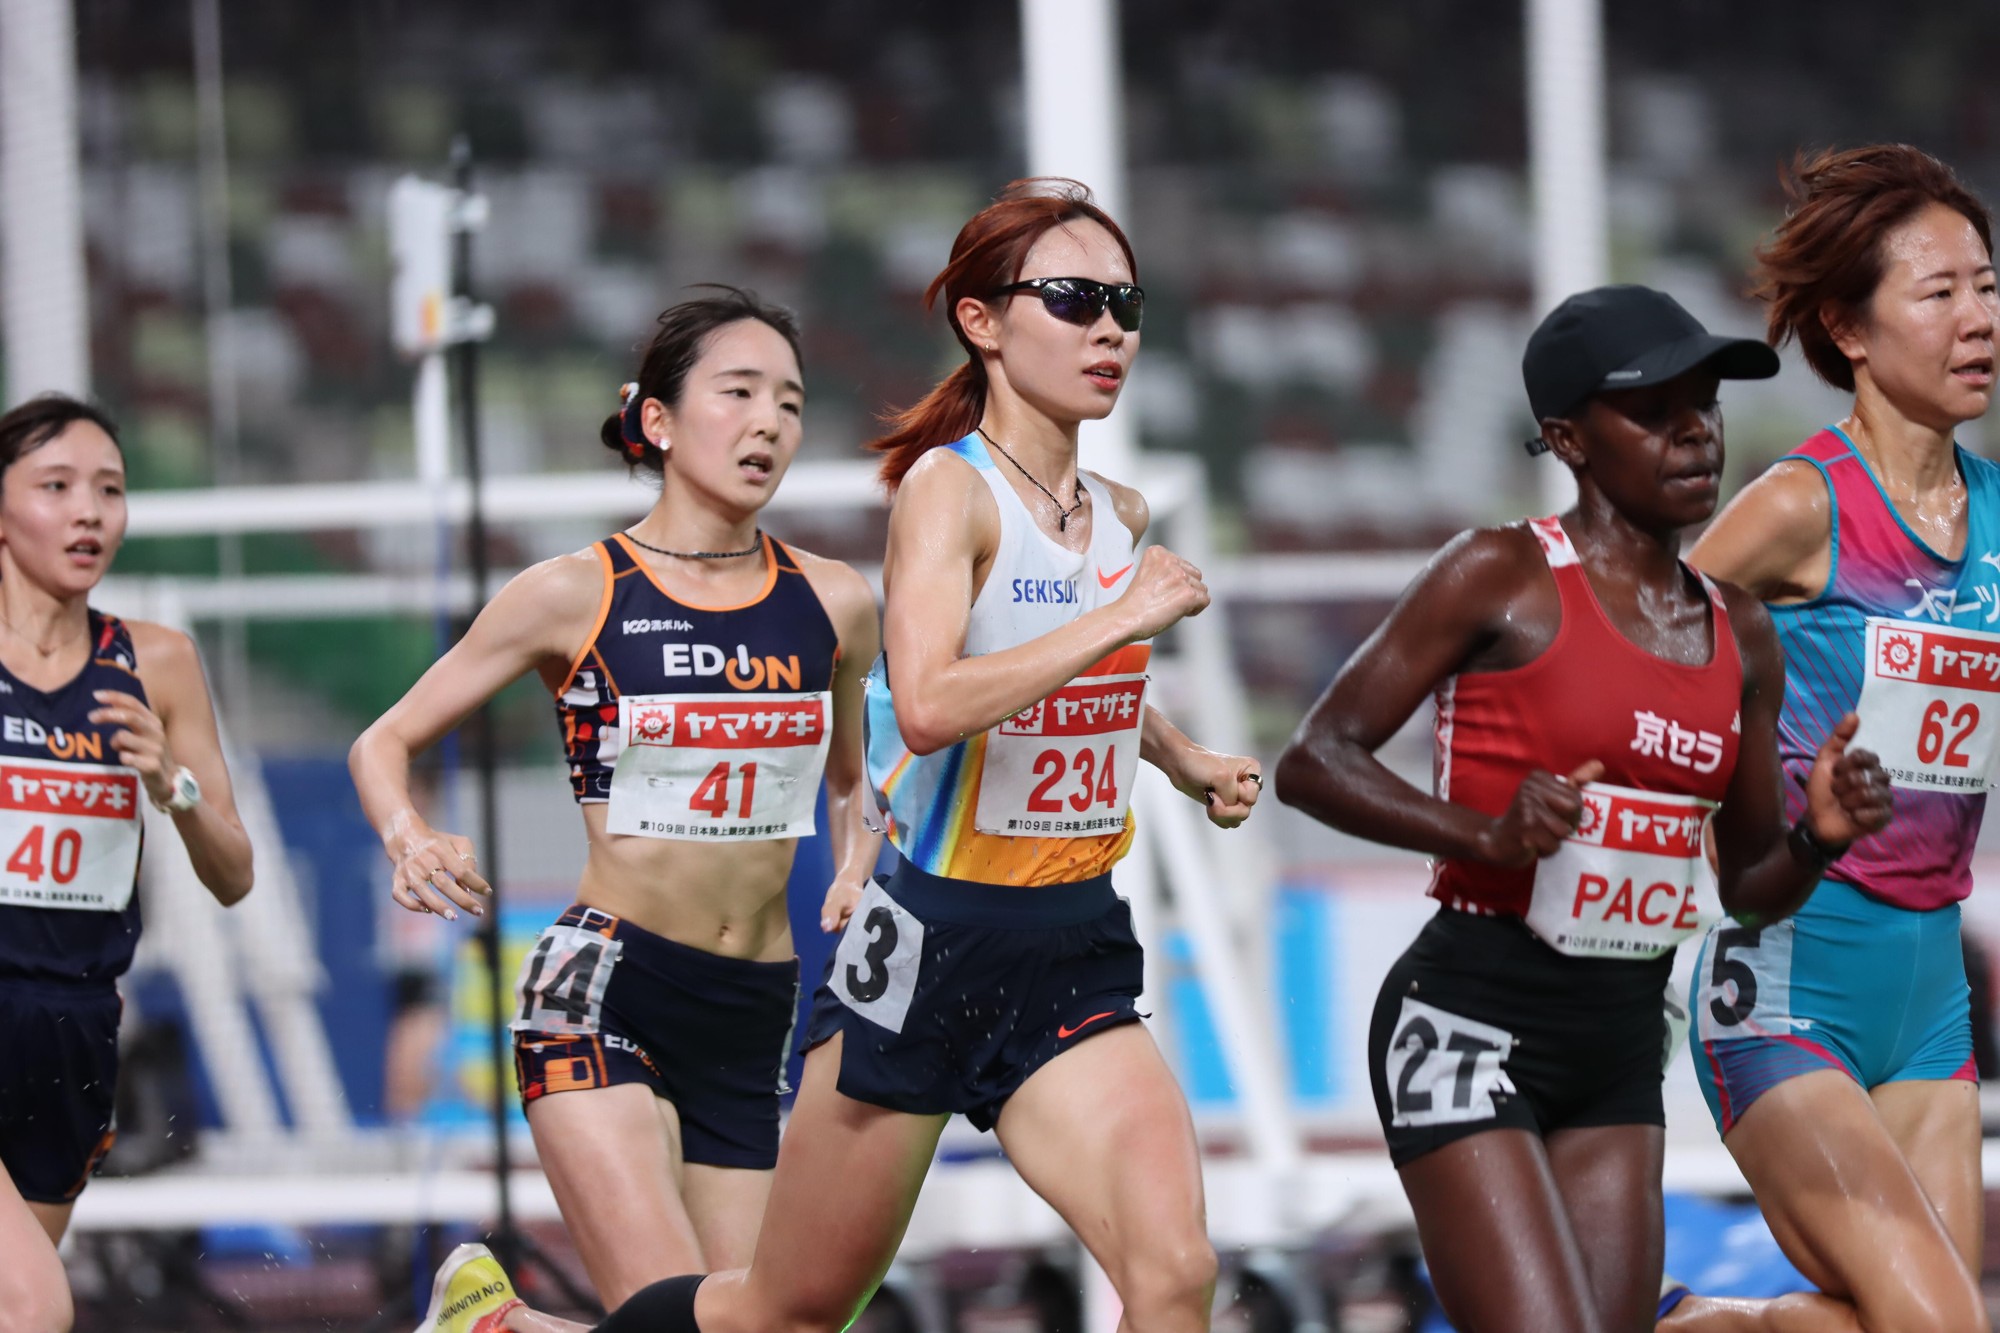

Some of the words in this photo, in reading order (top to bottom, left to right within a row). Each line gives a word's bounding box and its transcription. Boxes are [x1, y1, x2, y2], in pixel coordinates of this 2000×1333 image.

[1013, 578, 1078, 604] SEKISUI
[663, 643, 801, 690] EDION
[684, 711, 817, 740] ヤマザキ
[1053, 691, 1138, 726] ヤマザキ
[1916, 699, 1980, 768] 62
[3, 715, 103, 760] EDION
[1630, 710, 1723, 774] 京セラ
[8, 774, 130, 810] ヤマザキ
[689, 761, 757, 819] 41
[1026, 744, 1118, 813] 234
[639, 820, 685, 835] 第109回
[689, 822, 788, 836] 日本陸上競技選手権大会
[1008, 818, 1051, 832] 第109回
[6, 825, 83, 885] 40
[1572, 872, 1698, 929] PACE
[521, 935, 604, 1025] 14
[846, 906, 898, 1003] 3
[1710, 927, 1762, 1027] 5
[482, 1281, 505, 1297] ON
